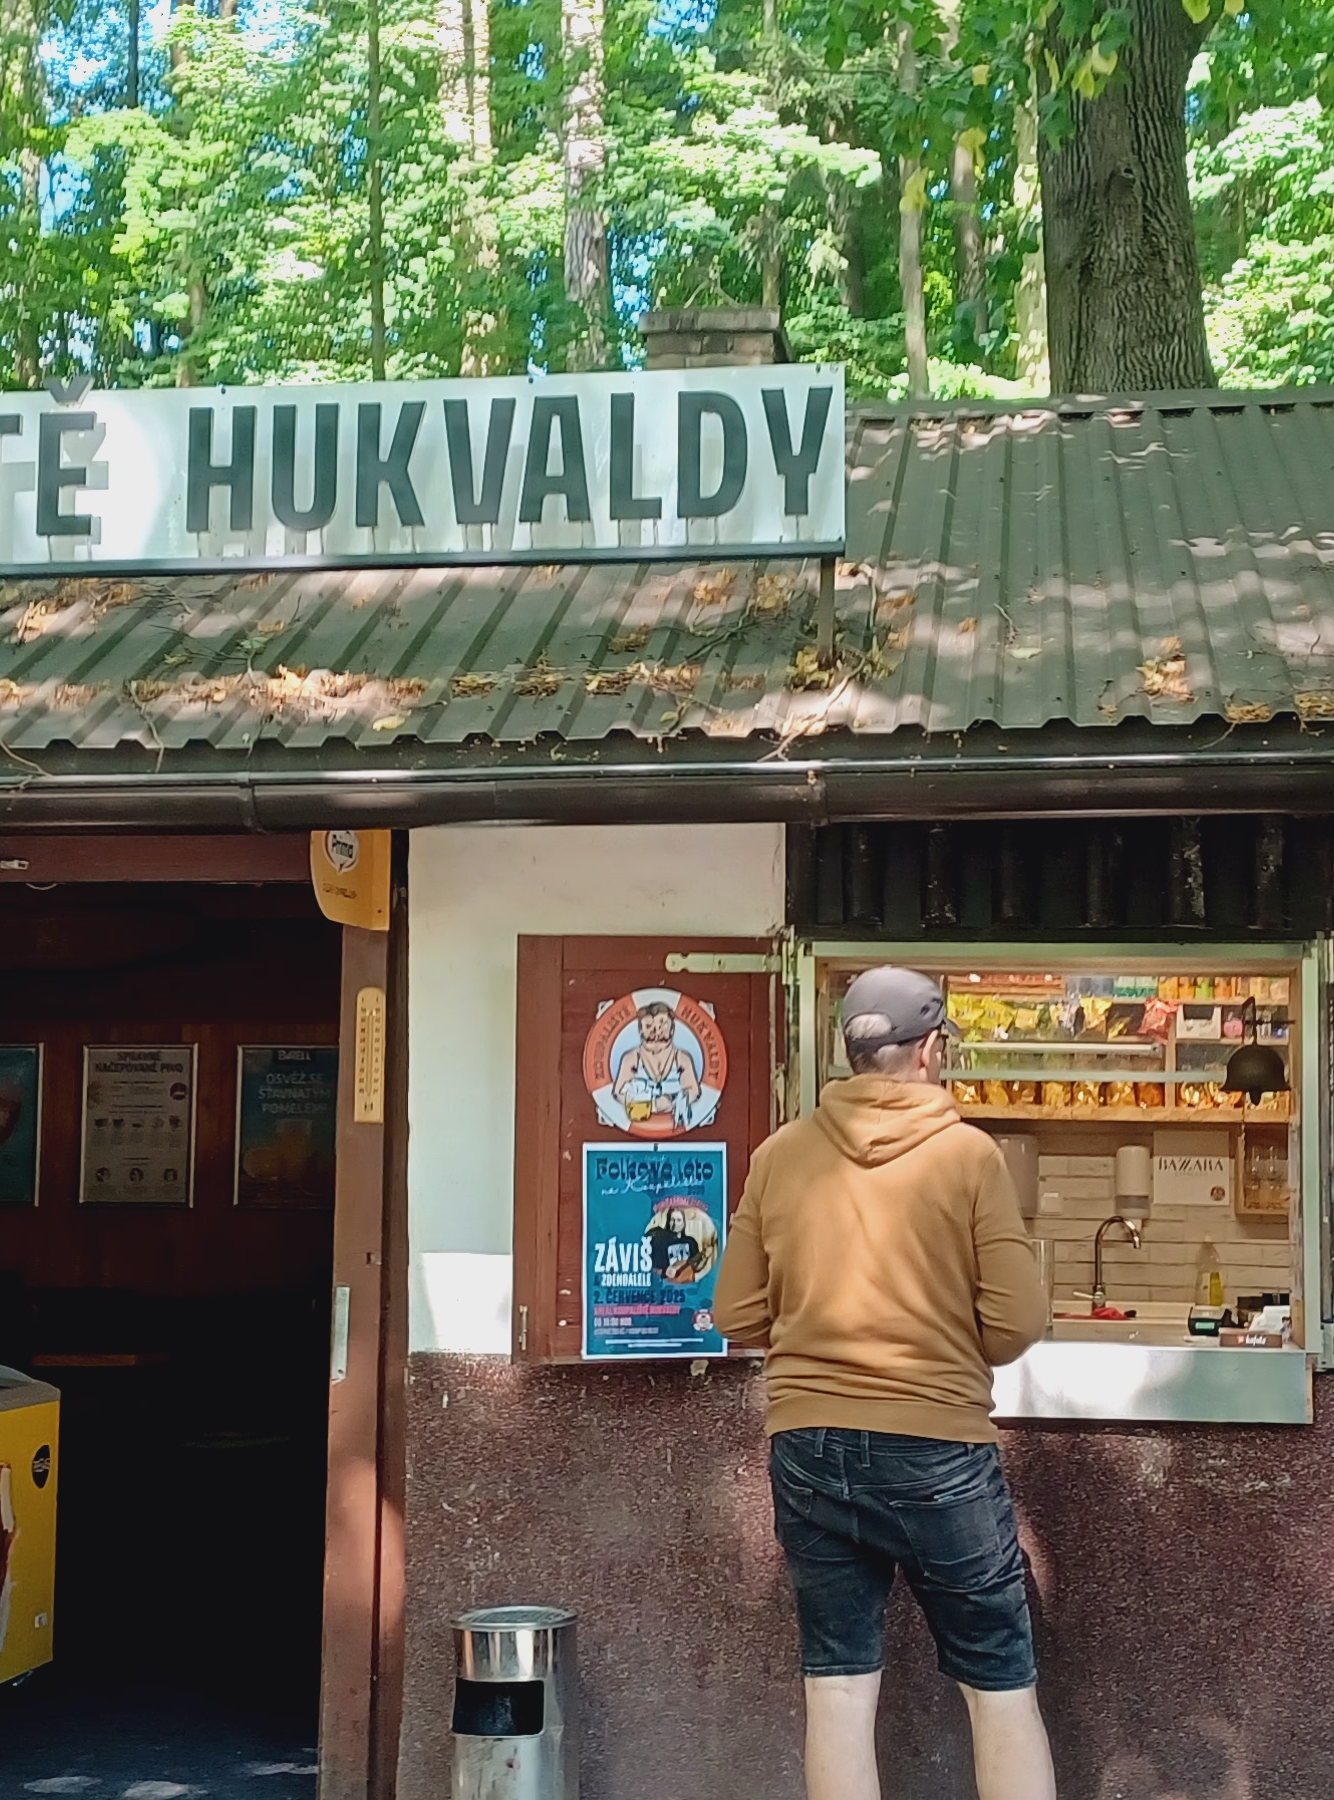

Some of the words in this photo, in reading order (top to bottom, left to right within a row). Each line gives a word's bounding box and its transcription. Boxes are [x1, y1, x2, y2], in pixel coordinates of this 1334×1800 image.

[186, 386, 834, 534] HUKVALDY
[1159, 1156, 1223, 1172] BAZZARA
[594, 1235, 653, 1273] ZÁVIŠ
[593, 1289, 604, 1304] 2.
[605, 1287, 656, 1304] ČERVENCE
[660, 1289, 686, 1304] 2025
